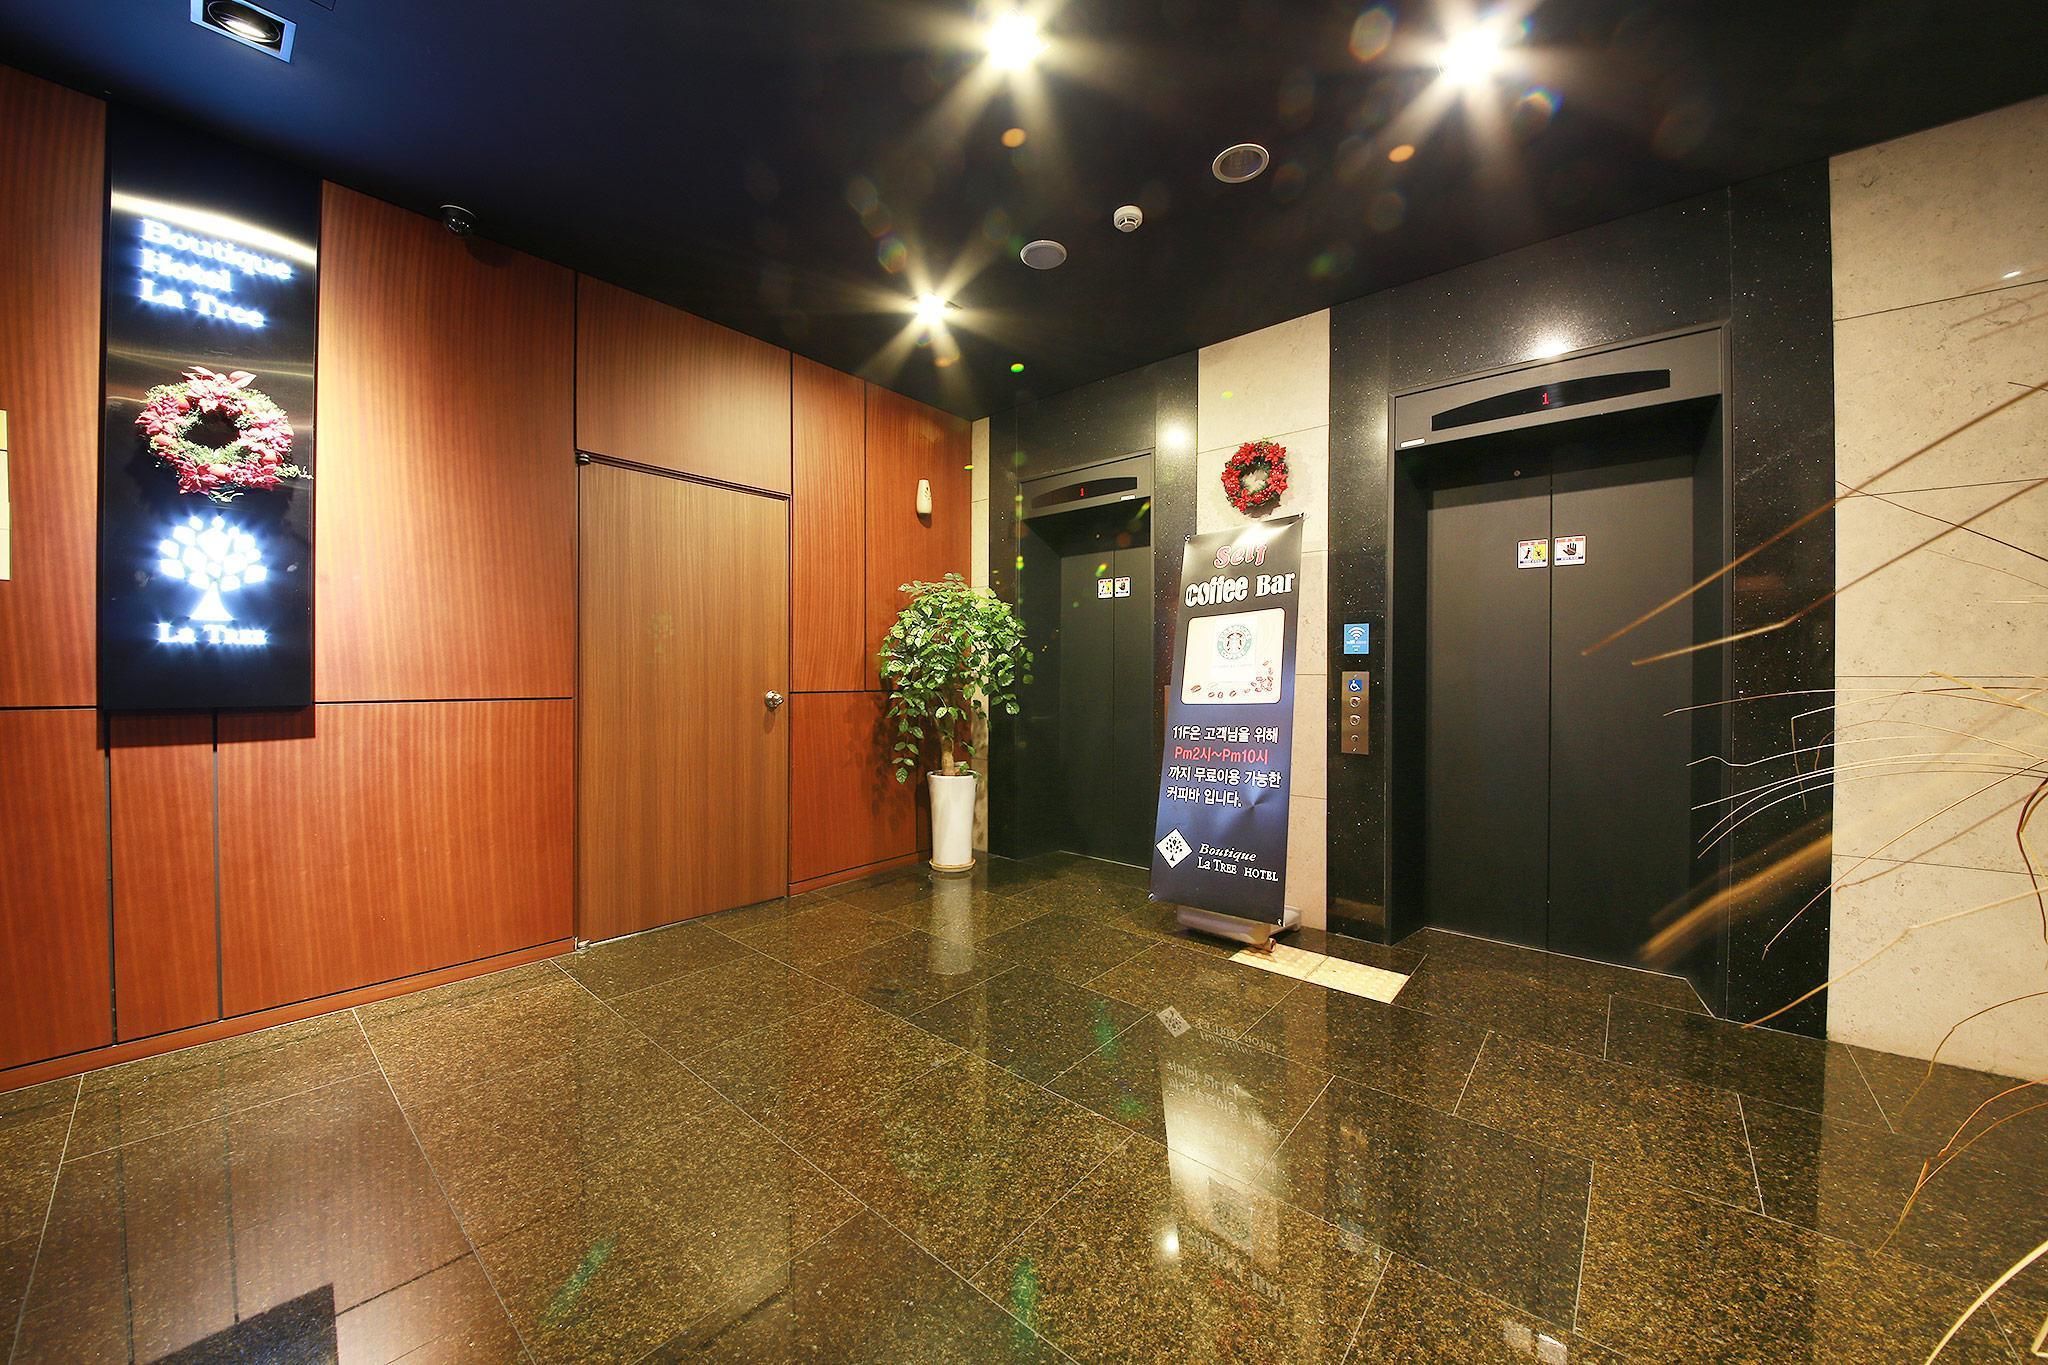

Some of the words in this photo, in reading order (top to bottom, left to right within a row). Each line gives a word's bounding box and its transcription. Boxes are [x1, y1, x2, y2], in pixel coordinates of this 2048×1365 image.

[141, 218, 292, 280] Boutique
[141, 248, 233, 292] Hotel
[141, 278, 186, 309] La
[191, 291, 264, 328] Tree
[1542, 392, 1549, 405] 1
[1255, 572, 1296, 597] Bar
[157, 622, 197, 644] La
[1172, 725, 1201, 741] 11F은
[1204, 726, 1250, 743] 고객님을
[1254, 727, 1279, 744] 위해
[1174, 746, 1269, 765] Pm2시~Pm10시
[1168, 766, 1191, 781] 까지
[1194, 767, 1241, 785] 무료이용
[1244, 770, 1281, 788] 가능한
[1166, 786, 1200, 803] 커피바
[1204, 788, 1242, 807] 입니다.
[1199, 843, 1257, 862] Boutique
[1212, 858, 1237, 875] TREE
[1244, 866, 1279, 882] HOTEL
